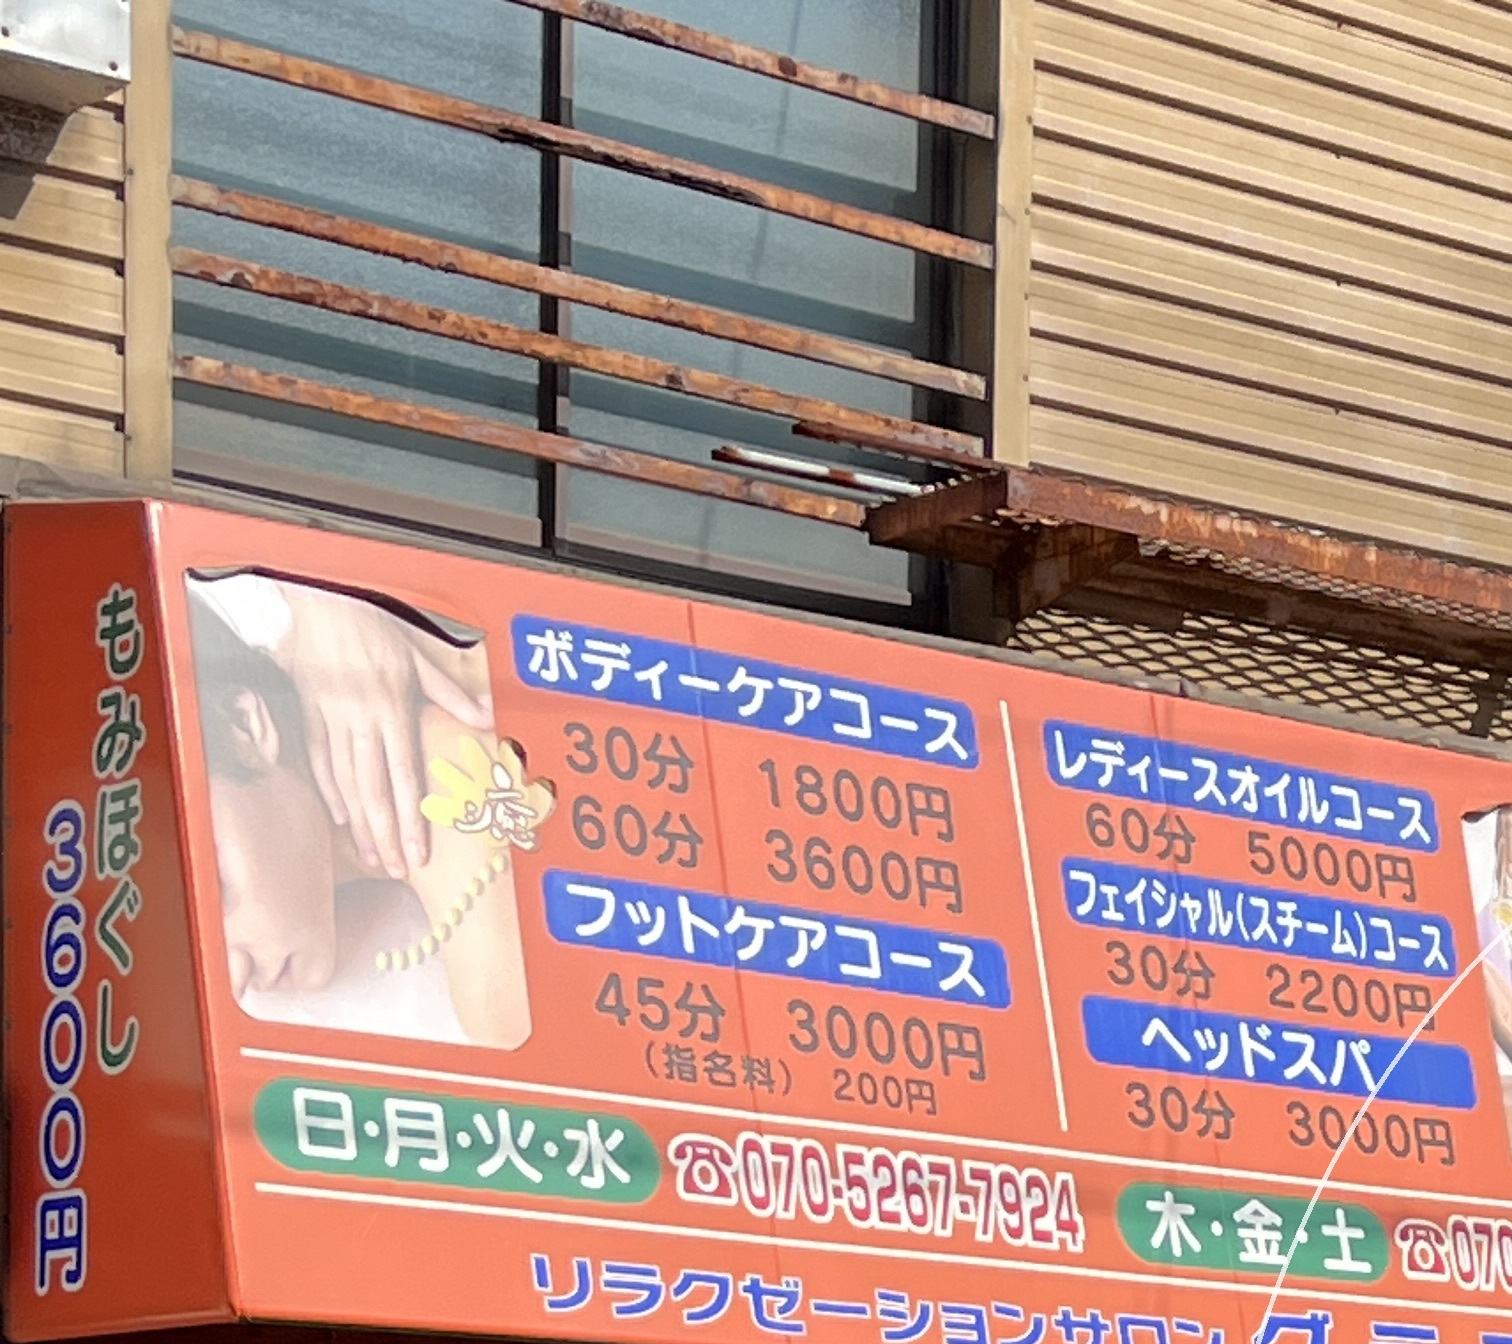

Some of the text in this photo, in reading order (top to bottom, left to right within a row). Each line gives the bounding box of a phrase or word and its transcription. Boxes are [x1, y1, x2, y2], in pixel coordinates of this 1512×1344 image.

[526, 629, 969, 760] ボディーケアコース
[95, 584, 144, 1074] もみほぐし
[563, 722, 955, 843] 30分 1800円
[1051, 729, 1432, 845] レディースオイルコース
[572, 796, 703, 868] 60分
[764, 830, 963, 914] 3600円
[1086, 804, 1417, 904] 60分 5000円
[566, 883, 985, 997] フットケアコース
[1106, 941, 1436, 1032] 30分 2200円
[35, 805, 88, 1296] 3600円
[595, 973, 985, 1082] 45分 3000円
[644, 1042, 937, 1115] (指名料) 200円
[1141, 1016, 1376, 1091] ヘッドスパ
[1126, 1083, 1456, 1166] 30分 3000円
[739, 1132, 1084, 1252] 070-5267-7924
